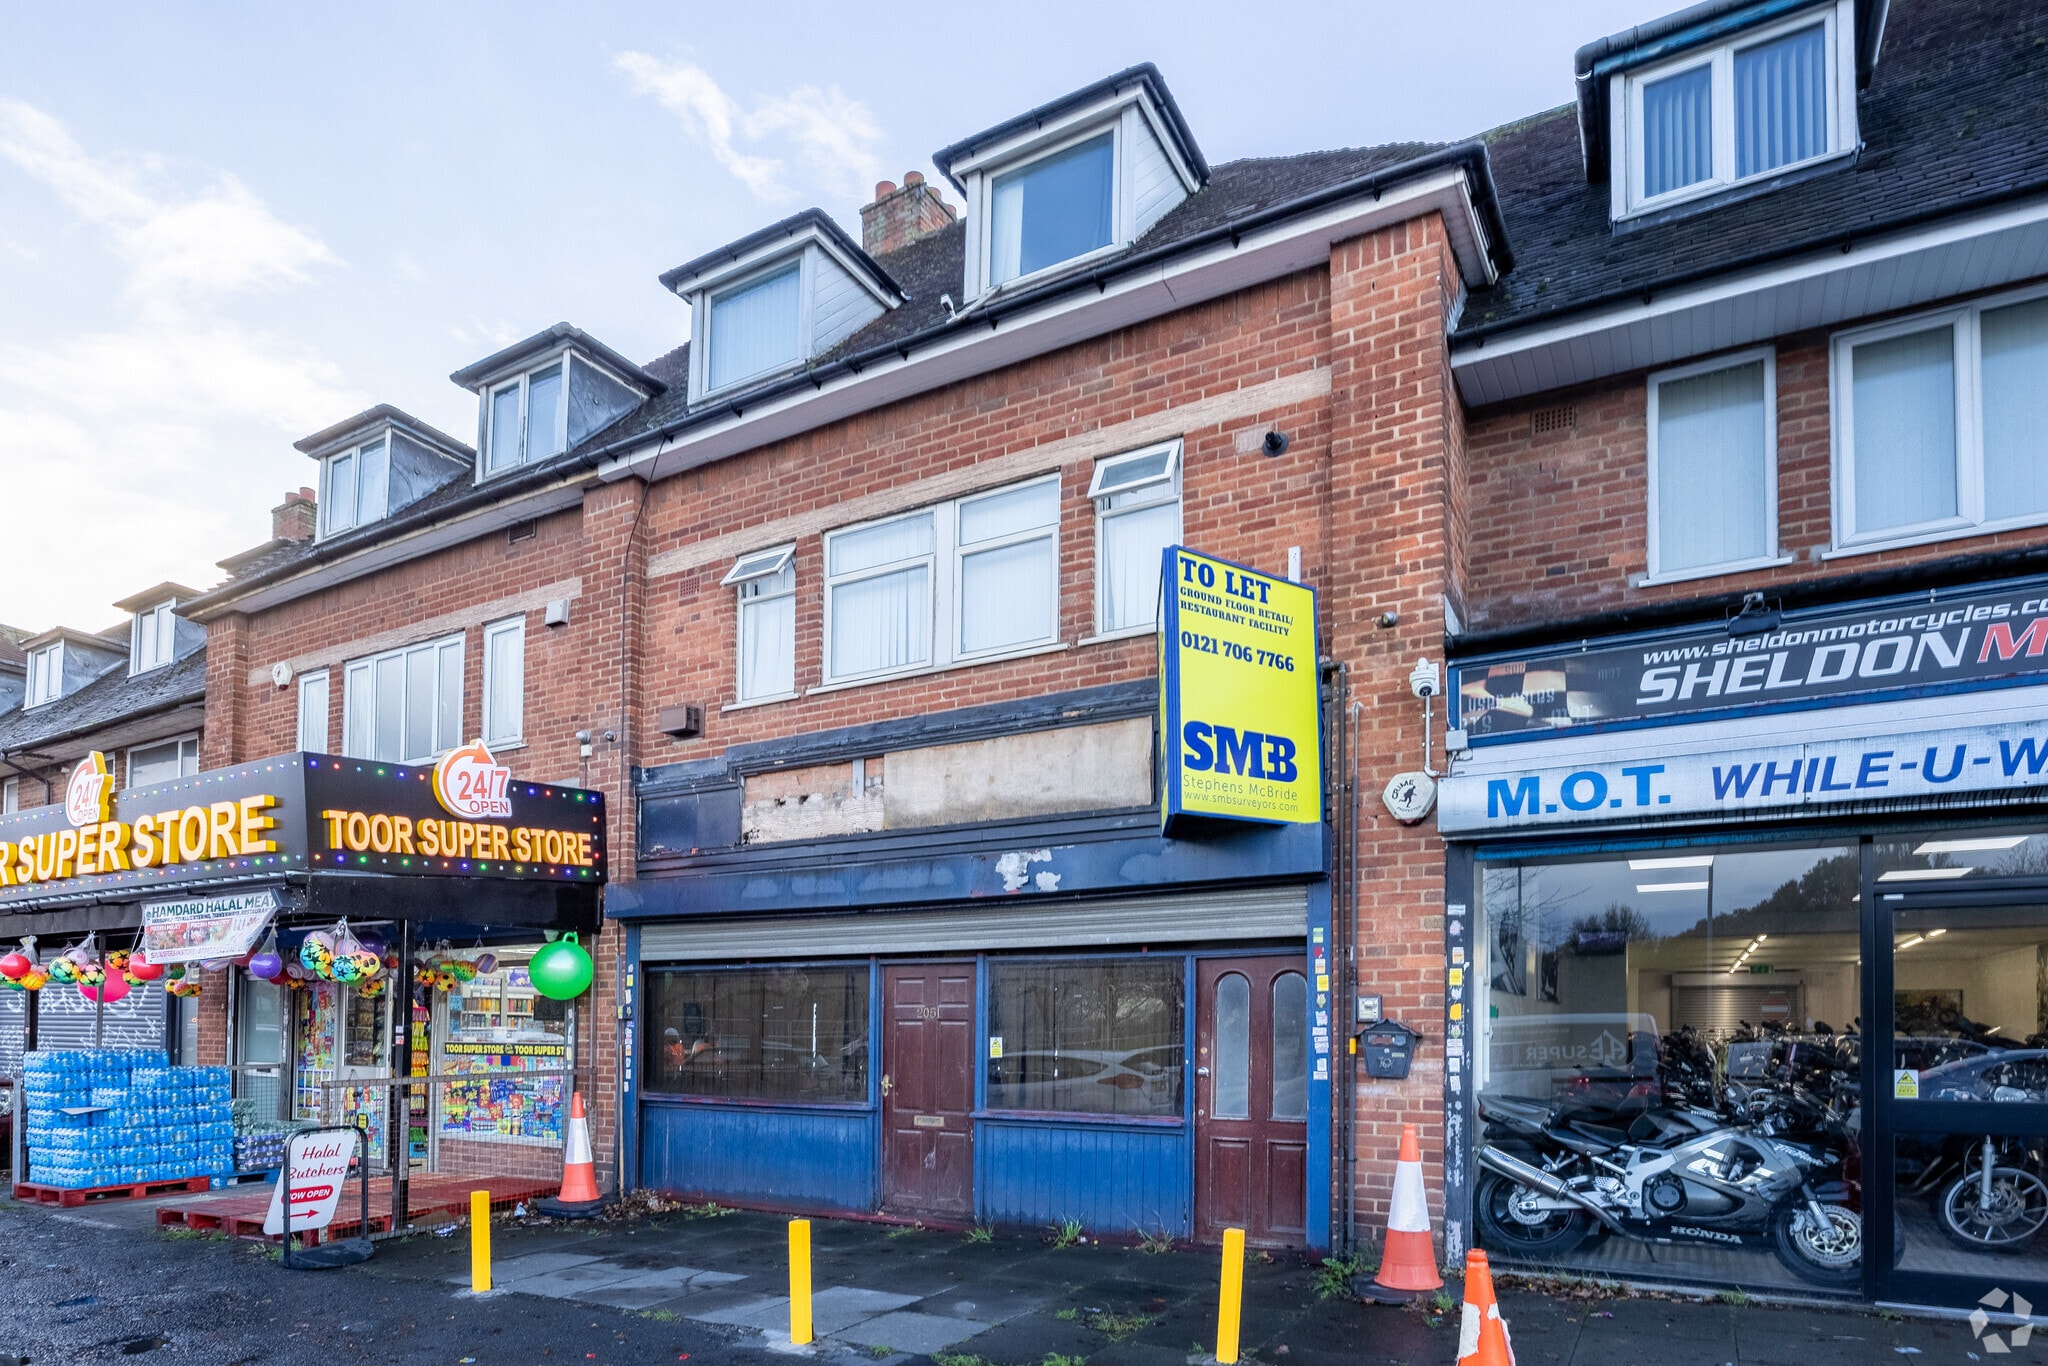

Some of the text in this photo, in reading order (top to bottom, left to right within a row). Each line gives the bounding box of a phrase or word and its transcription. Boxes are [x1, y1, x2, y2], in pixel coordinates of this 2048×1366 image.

[1180, 557, 1271, 604] TO LET
[1180, 586, 1294, 626] GROUND FLOOR RETAIL/
[1180, 600, 1289, 636] RESTAURANT FACILITY
[1181, 631, 1295, 672] 0121 706 7766
[1636, 626, 1972, 705] SHELDON
[1183, 720, 1298, 783] SMB
[458, 770, 508, 800] 24/7
[1183, 774, 1298, 801] Stephens McBride
[1391, 778, 1414, 800] CRIME
[1488, 737, 2048, 818] M.O.T. WHILE-U-W
[74, 776, 103, 812] 24/7
[469, 799, 509, 814] OPEN
[1184, 790, 1298, 812] www.smbsurveyors.com
[77, 807, 98, 820] OPEN
[16, 821, 127, 884] SUPER
[131, 794, 274, 868] STORE
[323, 809, 593, 867] TOOR SUPER STORE
[151, 903, 205, 918] HAMDARD
[206, 898, 243, 913] HALAL
[446, 1044, 462, 1053] TOOR
[463, 1044, 482, 1054] SUPER
[484, 1044, 504, 1054] STORE
[515, 1045, 533, 1055] TOOR
[534, 1045, 555, 1056] SUPER
[302, 1143, 342, 1160] Halal
[289, 1188, 330, 1201] OW OPEN
[1670, 1225, 1743, 1245] HONDA
